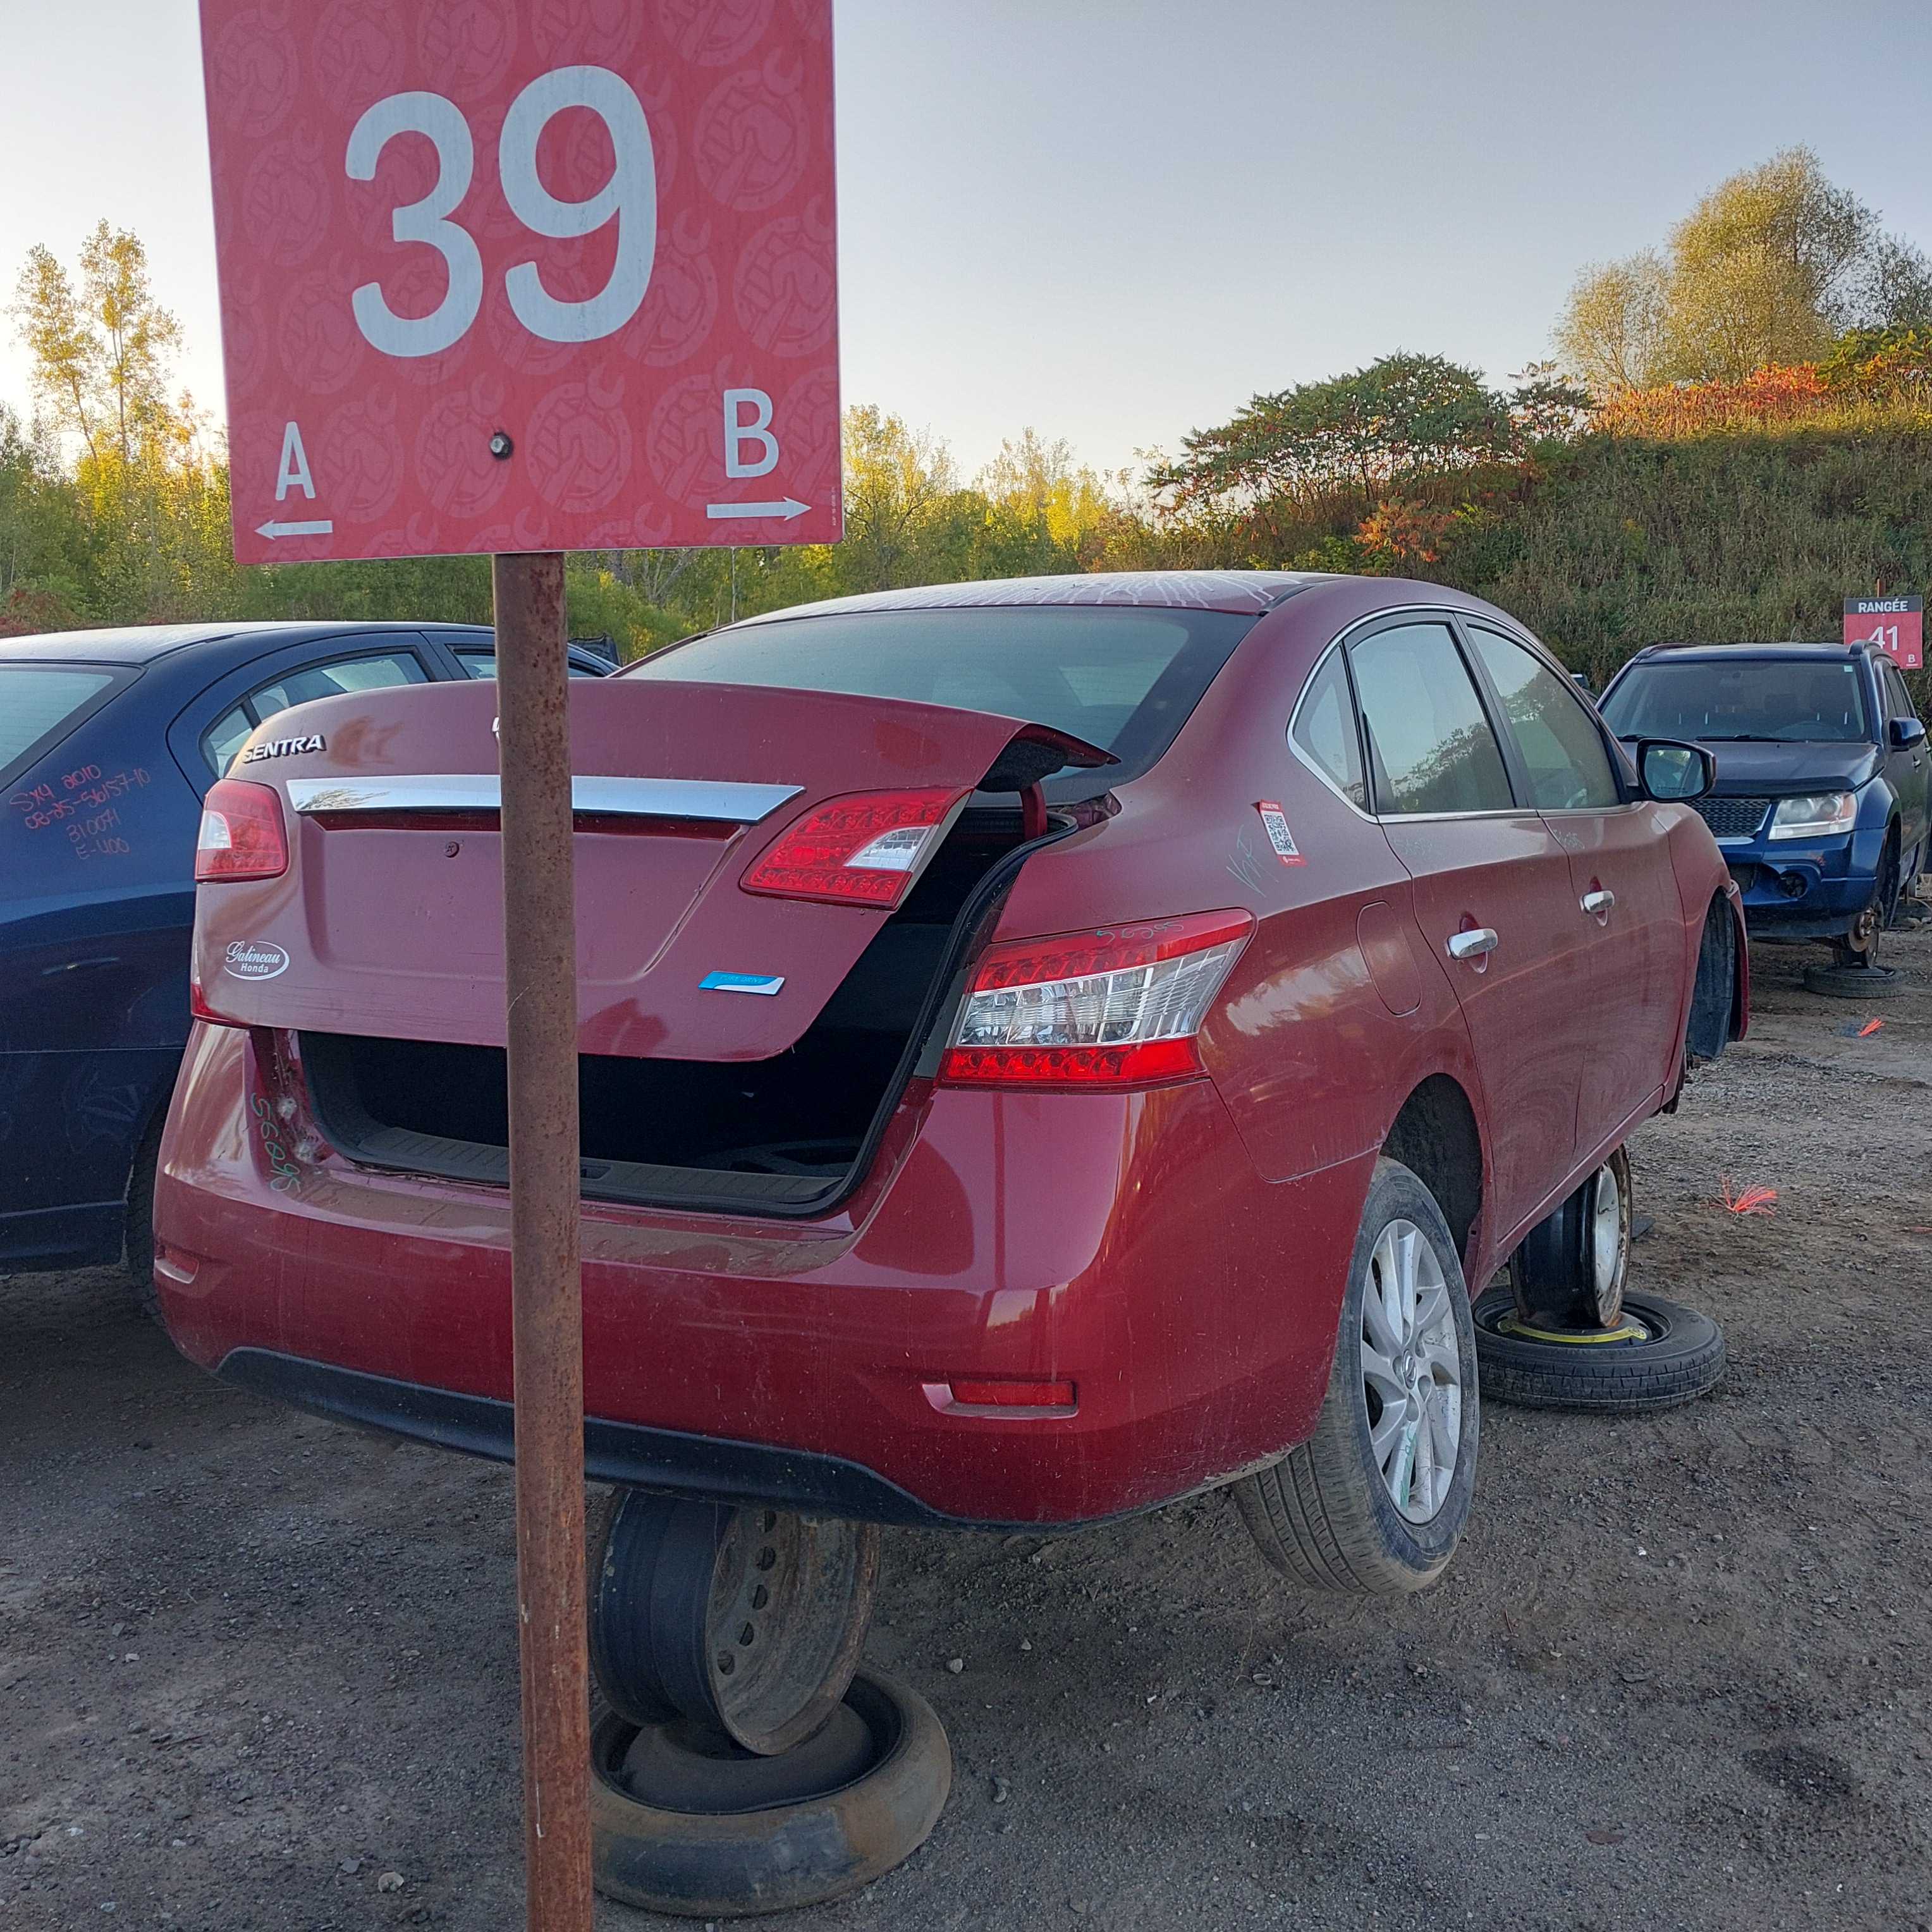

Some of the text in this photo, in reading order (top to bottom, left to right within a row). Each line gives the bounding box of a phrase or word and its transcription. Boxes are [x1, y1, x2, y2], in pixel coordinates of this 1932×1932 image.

[345, 65, 657, 357] 39
[723, 388, 780, 479] B
[275, 421, 316, 501] A
[1858, 598, 1908, 613] RANGÉE
[1868, 625, 1898, 651] 41
[1907, 654, 1916, 663] B
[242, 734, 326, 764] SENTRA
[61, 764, 101, 790] 2010
[241, 963, 269, 973] Honda
